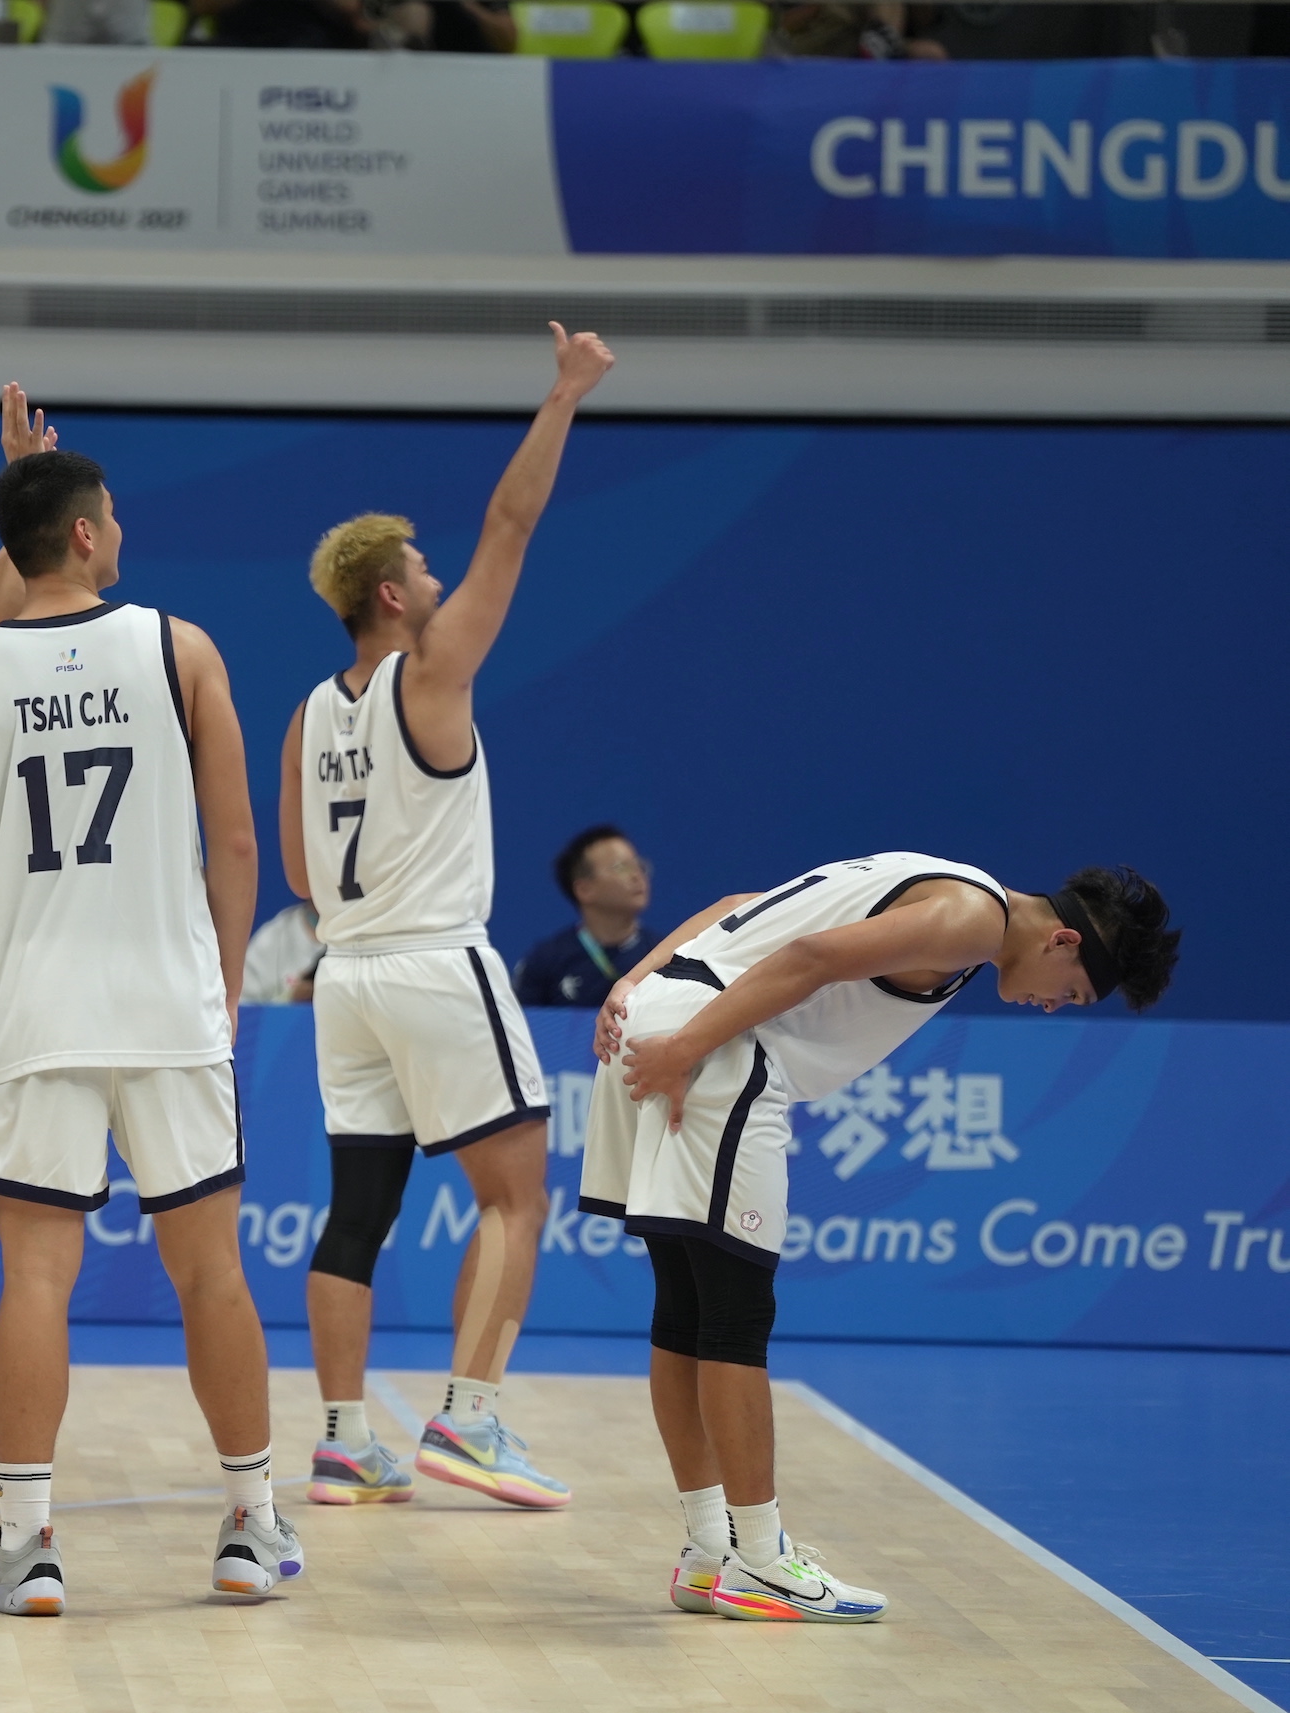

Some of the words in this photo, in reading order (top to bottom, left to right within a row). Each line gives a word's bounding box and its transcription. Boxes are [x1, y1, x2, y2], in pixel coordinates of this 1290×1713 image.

[259, 86, 355, 112] FISU
[259, 120, 358, 143] WORLD
[259, 150, 407, 173] UNIVERSITY
[258, 180, 351, 202] GAMES
[258, 210, 371, 233] SUMMER
[55, 664, 84, 673] FISU
[14, 694, 73, 733] TSAI
[79, 687, 129, 726] C.K.
[17, 746, 134, 874] 17
[329, 798, 365, 902] 7
[979, 1198, 1188, 1271] Come
